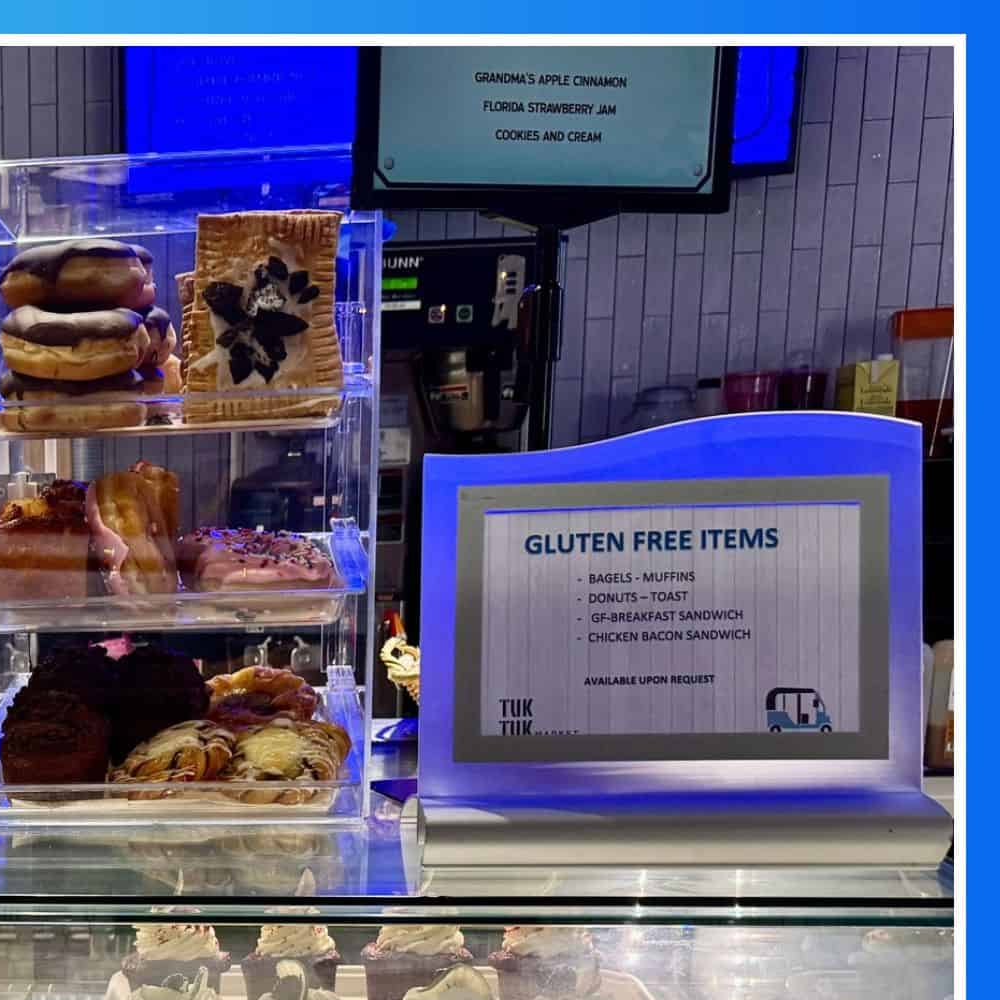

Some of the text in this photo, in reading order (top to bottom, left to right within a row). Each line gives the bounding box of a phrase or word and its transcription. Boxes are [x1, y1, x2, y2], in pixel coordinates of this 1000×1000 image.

[475, 72, 627, 88] GRANDMA'S APPLE CINNAMON
[483, 101, 616, 115] FLORIDA STRAWBERRY JAM
[495, 129, 601, 143] COOKIES AND CREAM
[524, 527, 779, 555] GLUTEN FREE ITEMS
[588, 573, 632, 584] BAGELS
[643, 571, 695, 583] MUFFINS
[588, 592, 638, 604] DONUTS
[650, 591, 688, 602] TOAST
[591, 609, 744, 623] GF-BREAKFAST SANDWICH
[588, 629, 751, 643] CHICKEN BACON SANDWICH
[584, 674, 715, 686] AVAILABLE UPON REQUEST
[499, 698, 533, 717] TUK
[499, 720, 533, 736] TUK
